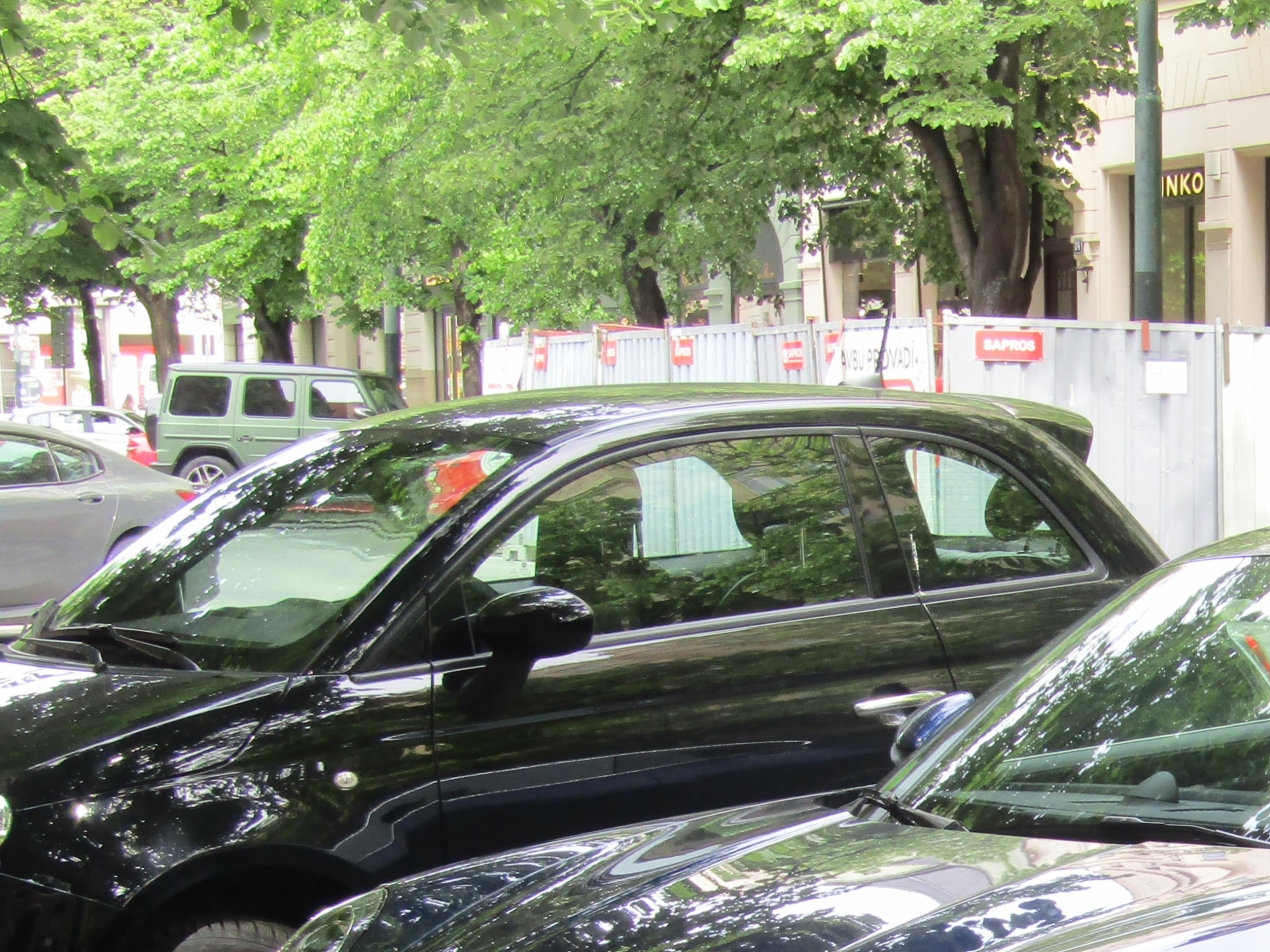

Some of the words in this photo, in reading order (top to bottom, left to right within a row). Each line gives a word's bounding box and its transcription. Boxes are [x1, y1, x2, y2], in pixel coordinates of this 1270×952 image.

[1161, 171, 1204, 197] INKO
[983, 339, 1036, 352] SAPROS
[841, 348, 865, 371] AVBU
